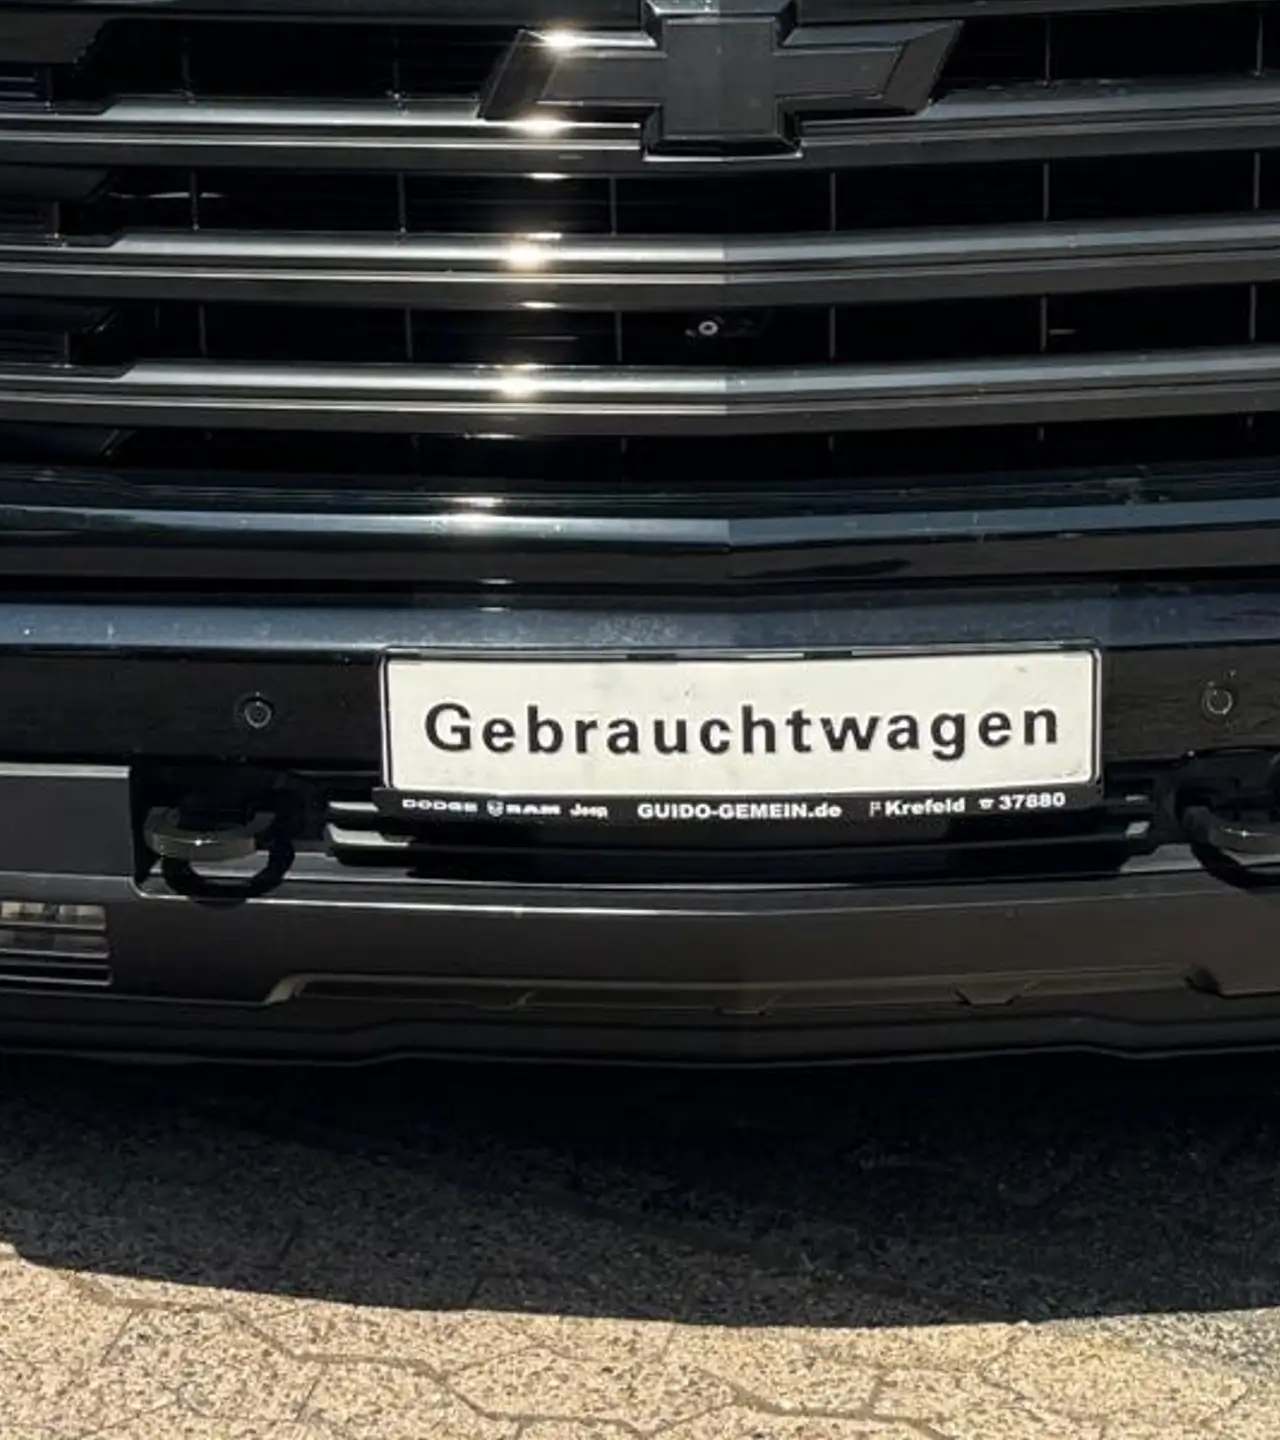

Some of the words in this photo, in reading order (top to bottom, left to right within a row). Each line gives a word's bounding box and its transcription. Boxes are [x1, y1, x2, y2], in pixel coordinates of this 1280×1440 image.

[424, 701, 1059, 762] Gebrauchtwagen
[637, 802, 842, 820] GUIDO-GEMEIN.de
[884, 797, 966, 816] Krefeld
